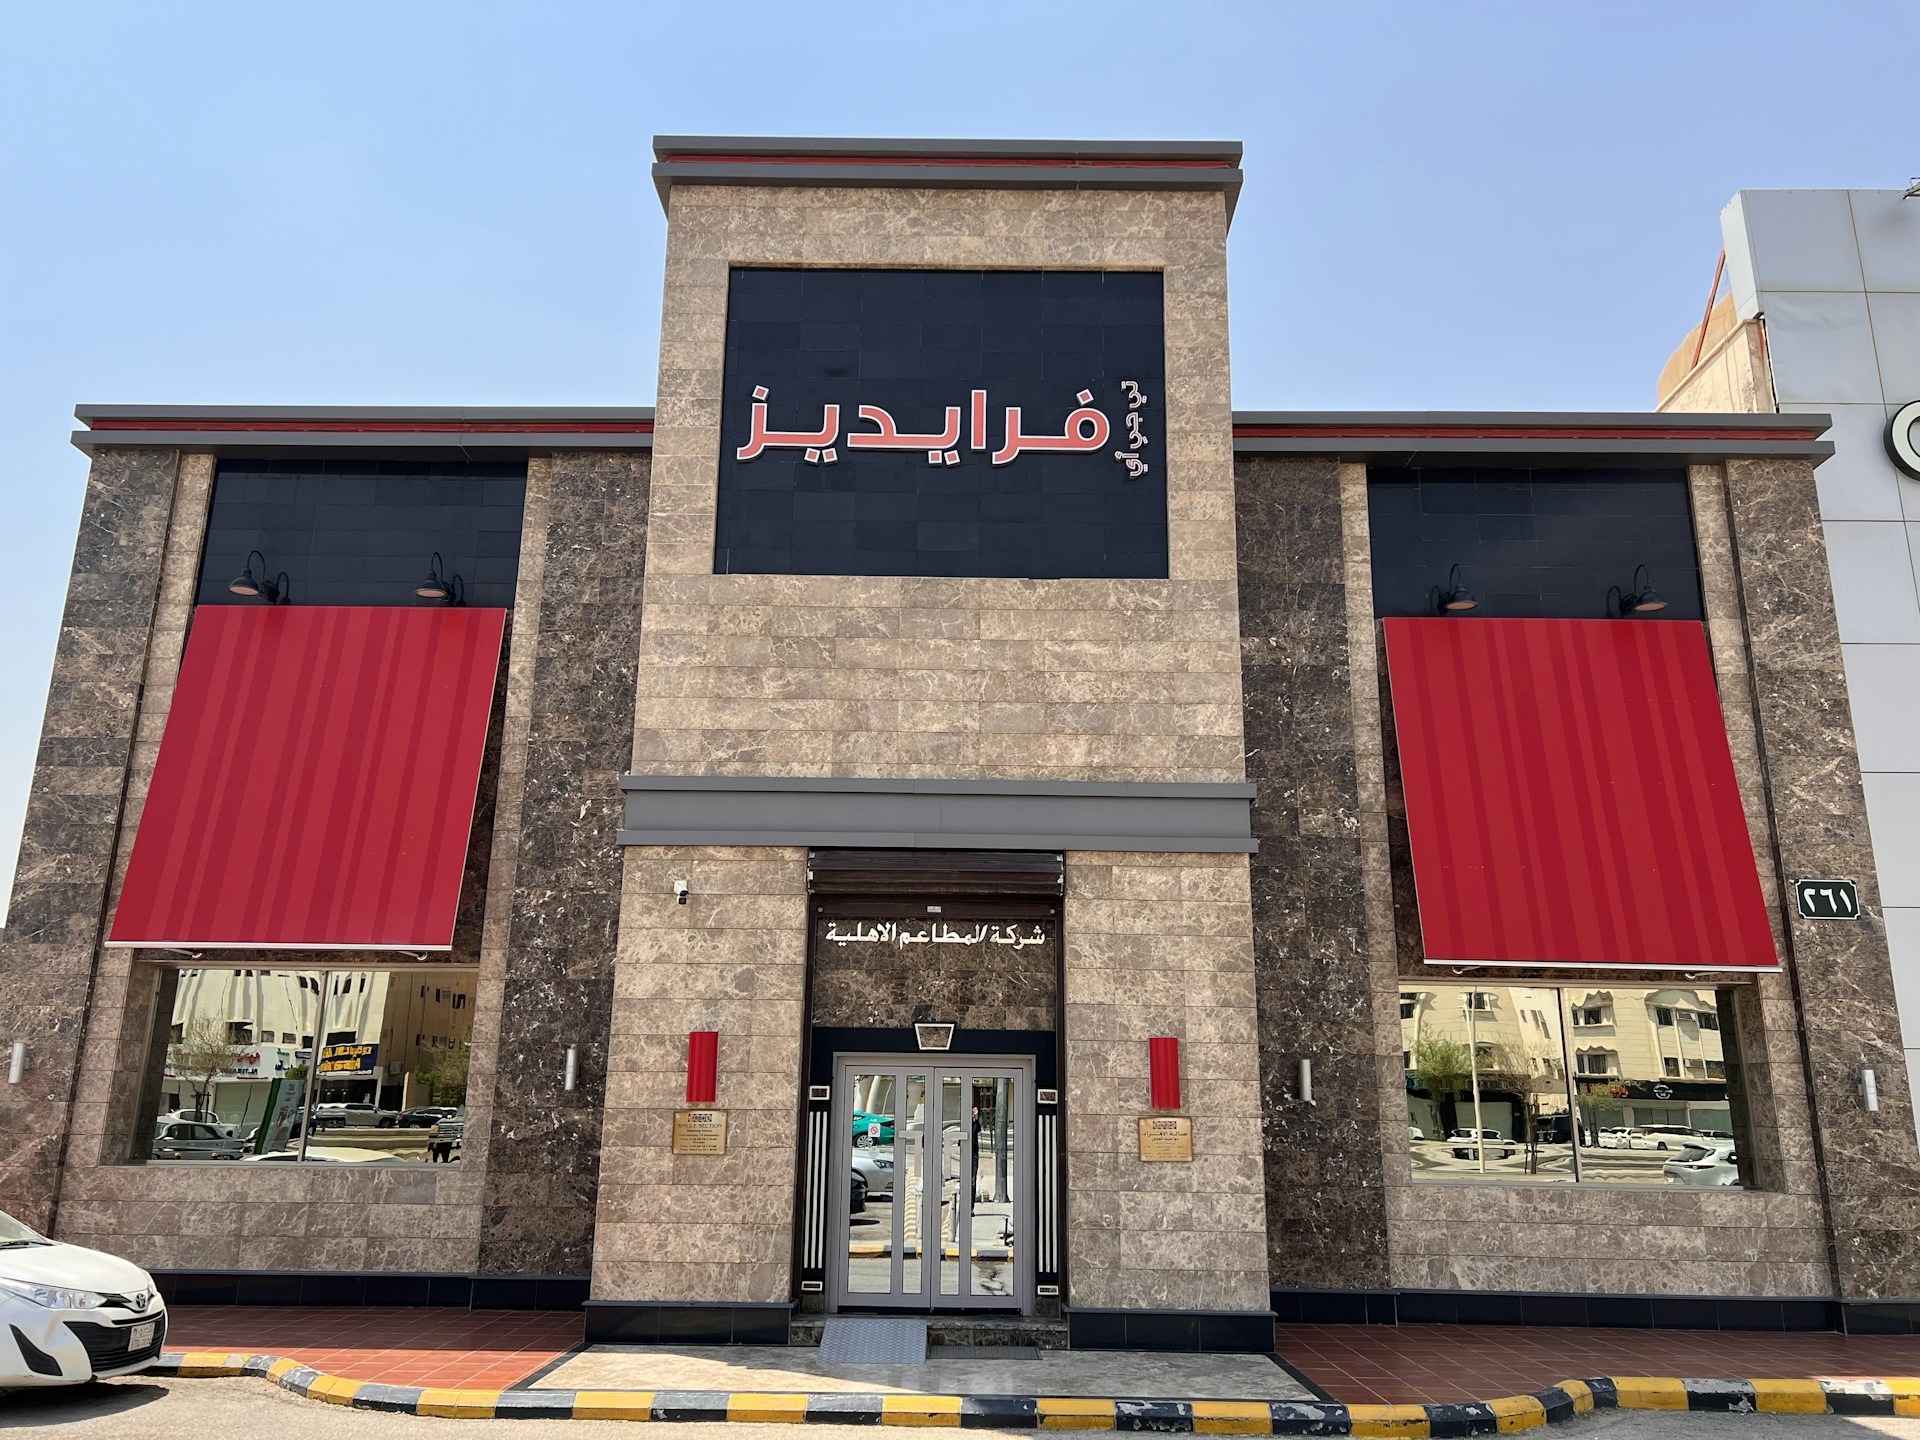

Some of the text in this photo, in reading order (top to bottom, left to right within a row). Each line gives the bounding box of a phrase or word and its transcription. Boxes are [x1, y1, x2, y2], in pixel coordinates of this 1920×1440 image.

[1121, 381, 1147, 408] تي
[736, 384, 1111, 467] فرايديز
[1126, 412, 1148, 449] جي
[1803, 888, 1852, 913] ٢٦١
[825, 921, 1045, 950] شركة المطاعم الاهلية
